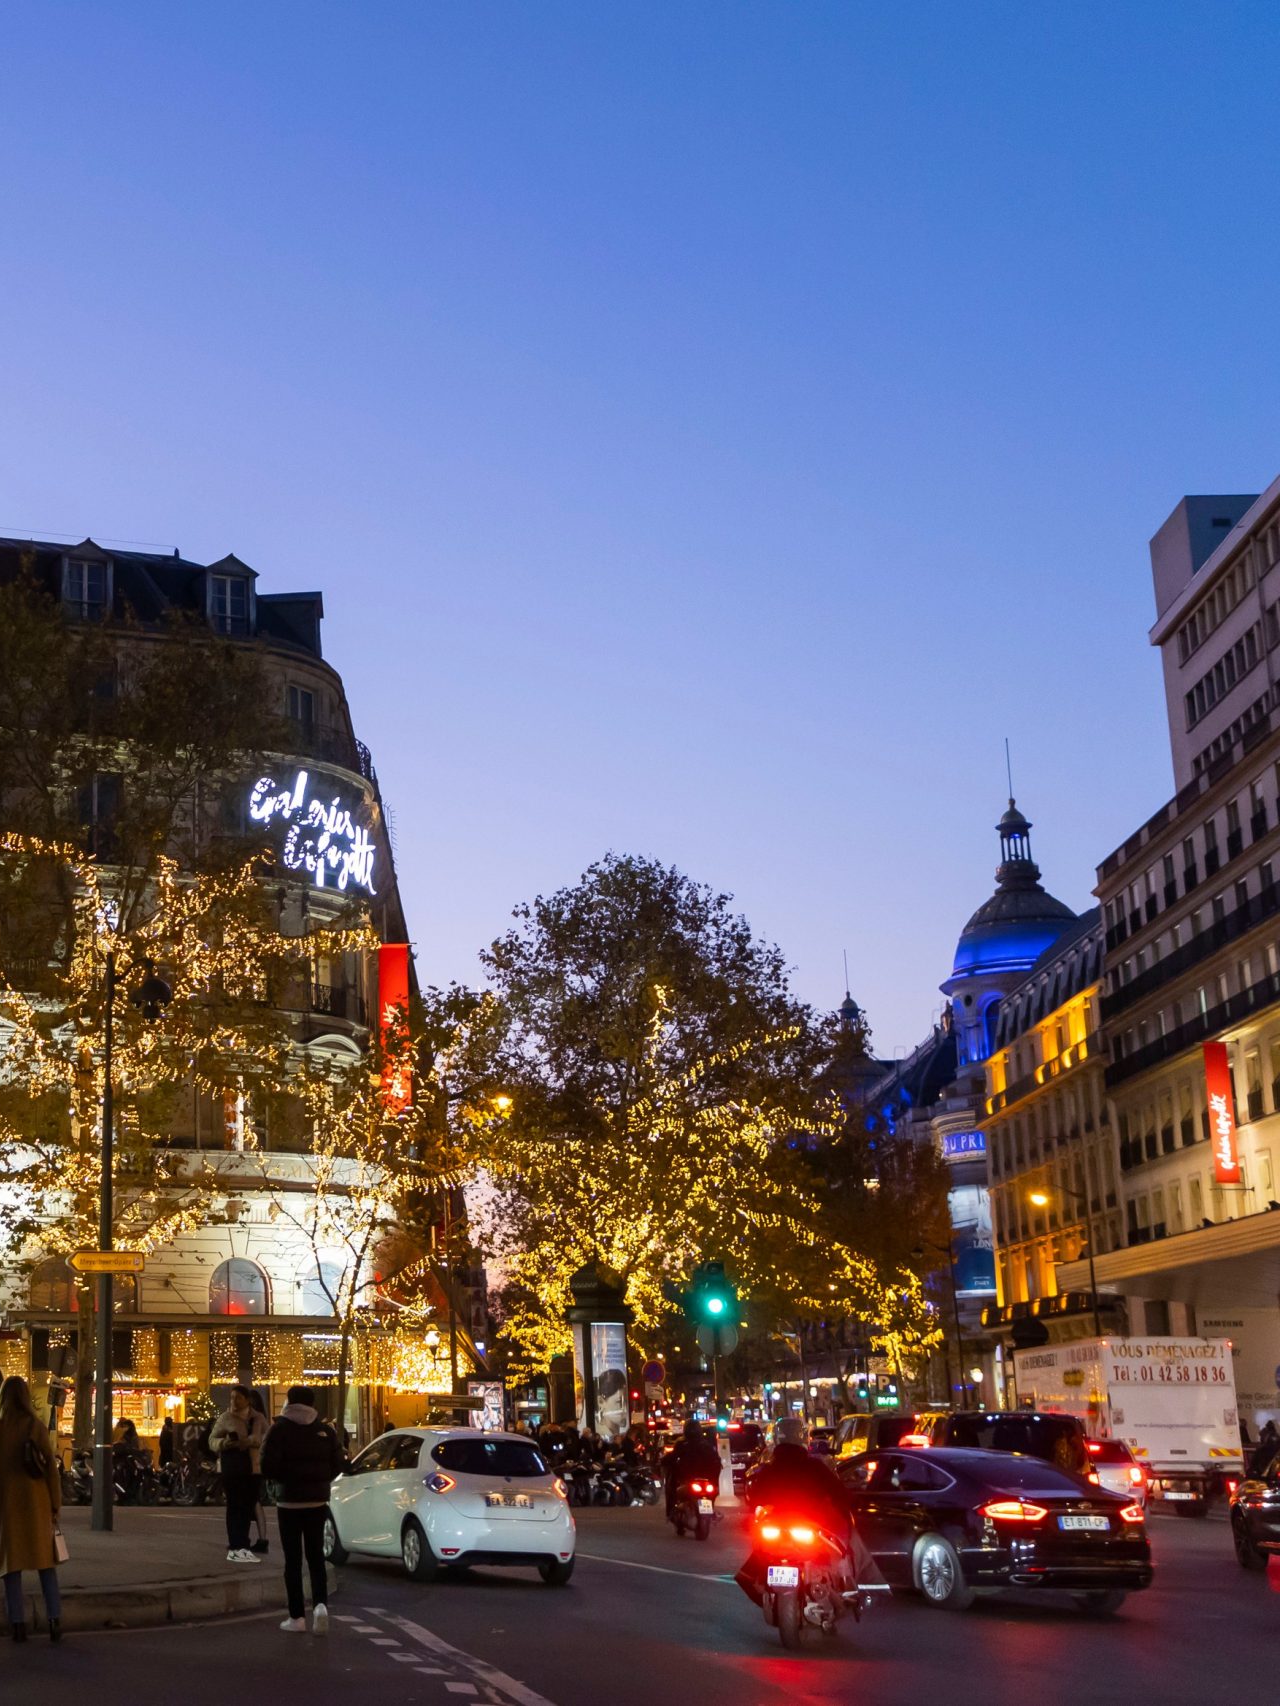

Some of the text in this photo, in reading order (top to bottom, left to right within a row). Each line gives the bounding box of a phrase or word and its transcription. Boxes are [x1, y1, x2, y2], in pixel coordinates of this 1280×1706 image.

[1110, 1345, 1143, 1358] VOUS
[1140, 1366, 1154, 1382] 01
[1158, 1366, 1172, 1382] 42
[1176, 1366, 1190, 1382] 58
[1194, 1366, 1208, 1382] 18
[1212, 1366, 1226, 1382] 36
